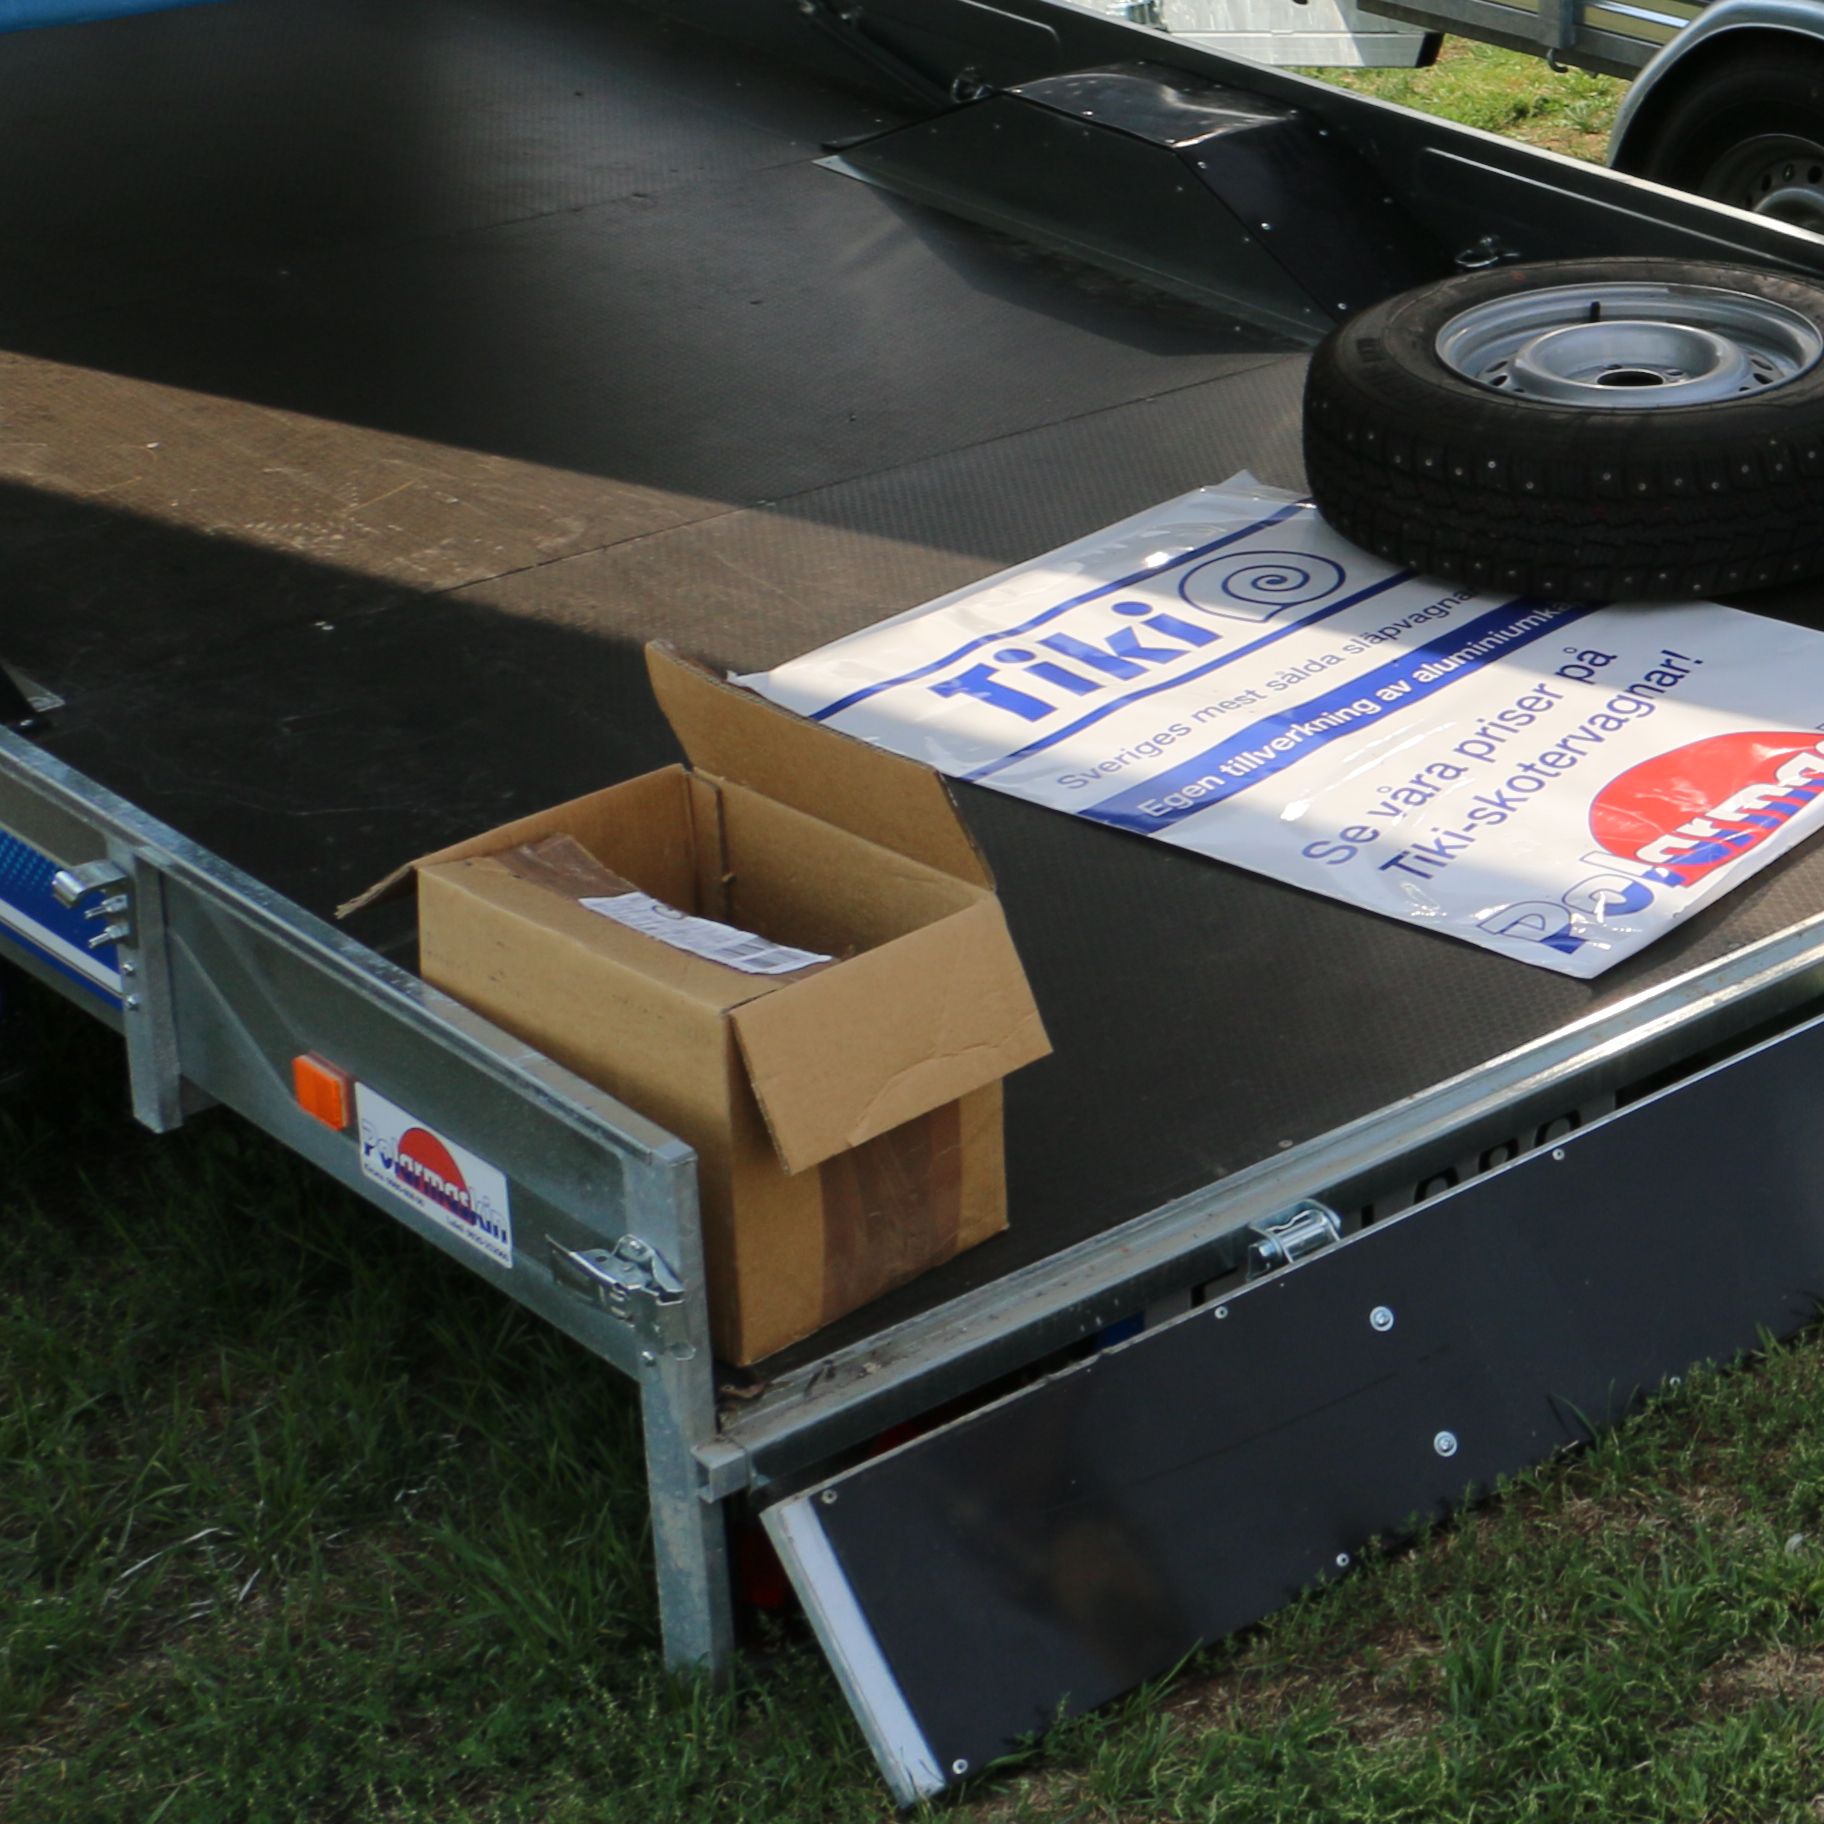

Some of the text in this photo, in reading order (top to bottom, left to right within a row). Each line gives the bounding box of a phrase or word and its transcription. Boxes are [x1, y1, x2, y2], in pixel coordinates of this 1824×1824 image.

[930, 599, 1223, 724] Tiki
[1057, 720, 1193, 791] Sveriges
[1191, 686, 1268, 724] mest
[1264, 651, 1346, 693] sålda
[1136, 771, 1227, 818] Egen
[1219, 695, 1382, 778] tillverkning
[1375, 678, 1414, 703] av
[1301, 645, 1618, 867] Se våra priser på
[1378, 648, 1705, 881] Tiki-skotervagnar!
